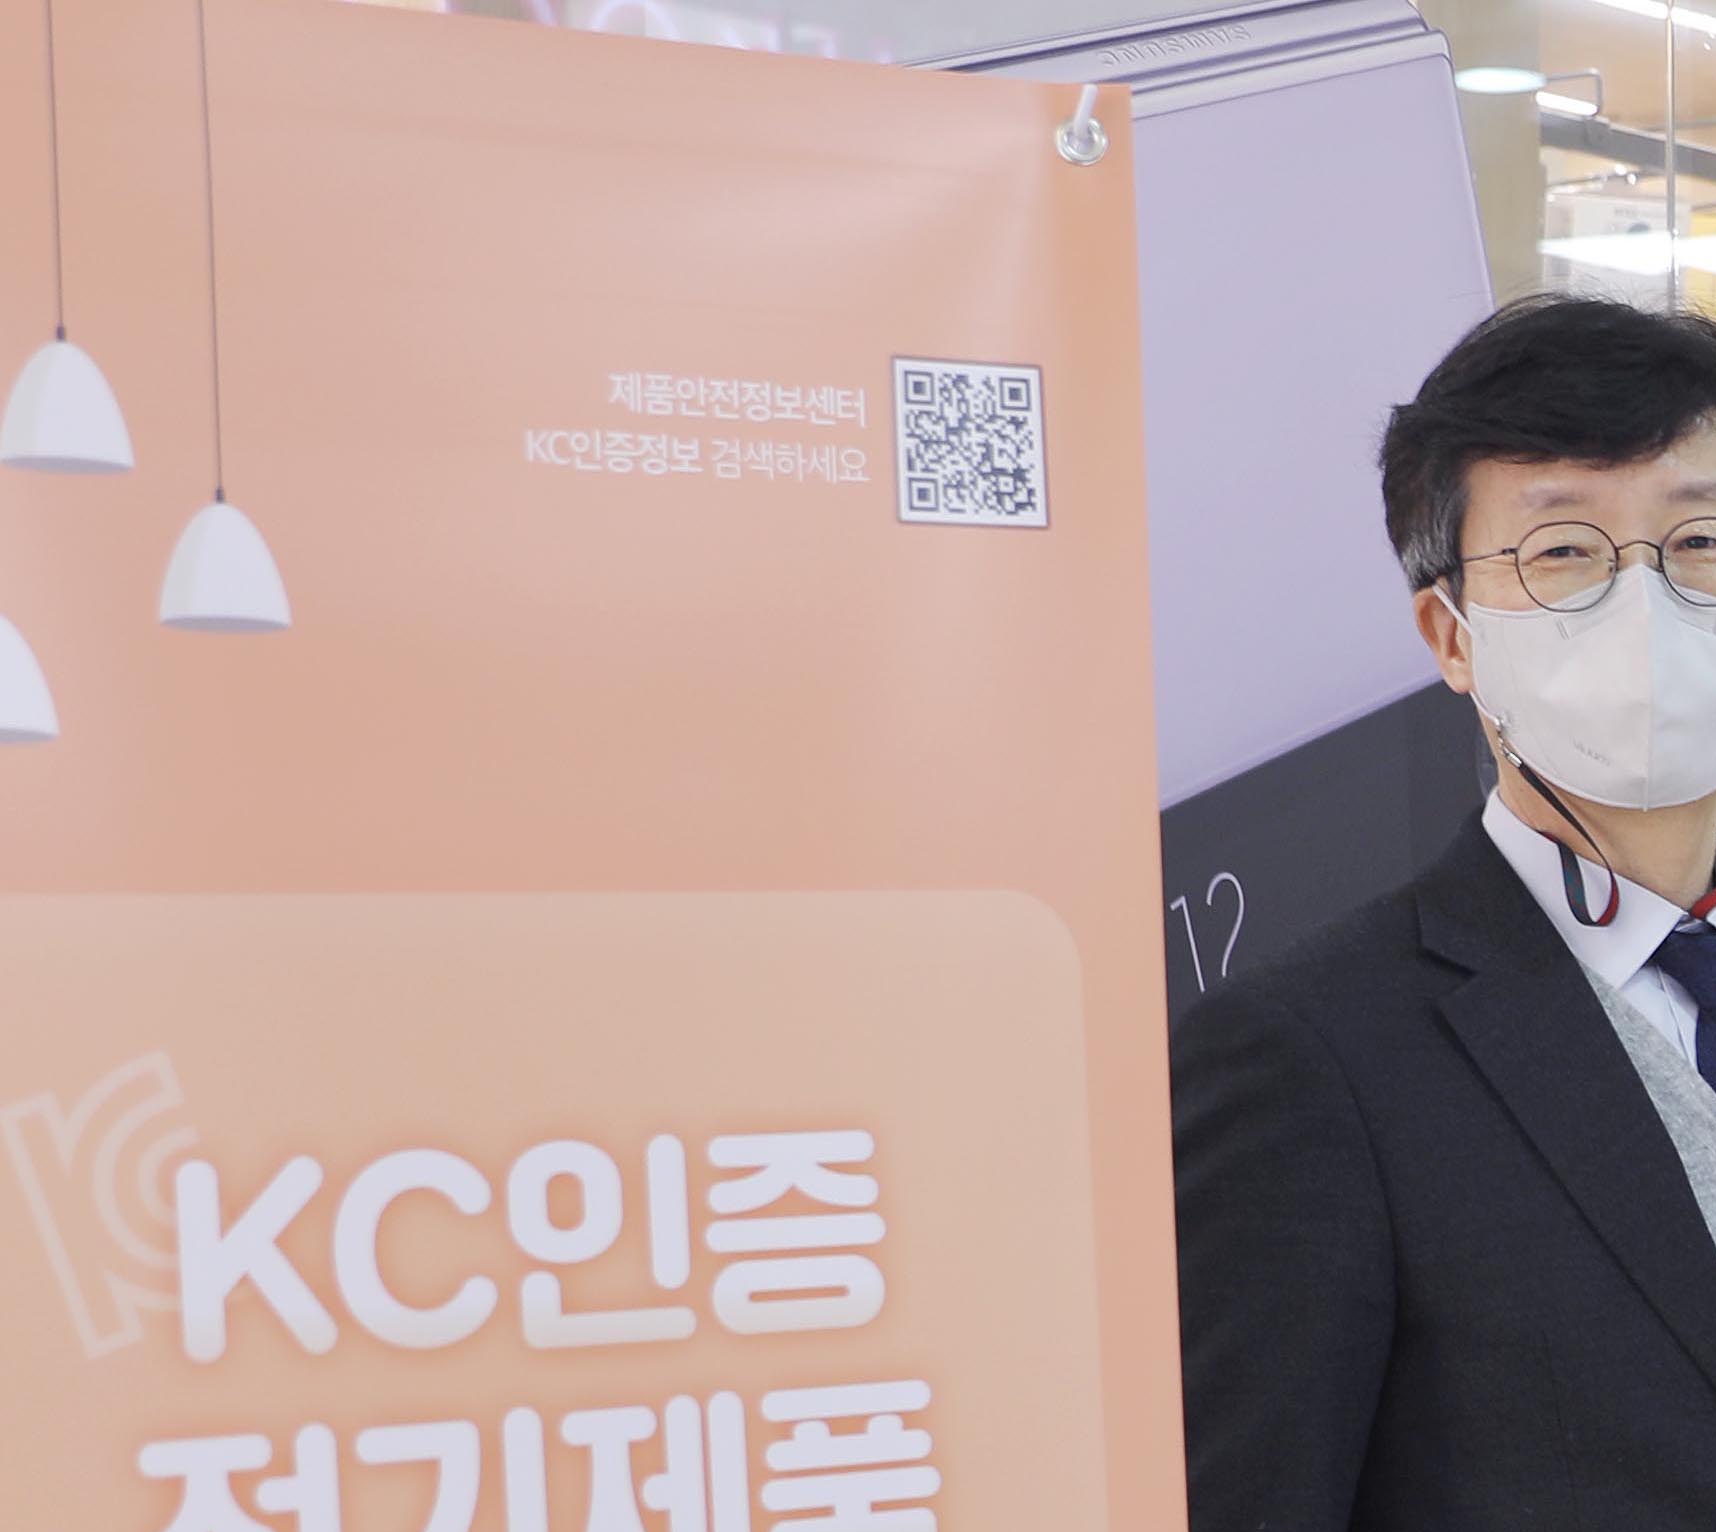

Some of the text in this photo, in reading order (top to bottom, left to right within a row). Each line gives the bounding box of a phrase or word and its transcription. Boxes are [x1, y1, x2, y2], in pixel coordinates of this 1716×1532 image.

[1096, 23, 1254, 67] SAMSUNG
[608, 372, 867, 428] 제품안전정보센터
[524, 429, 871, 484] KC인증정보 검색하세요
[174, 1128, 888, 1363] KC인증
